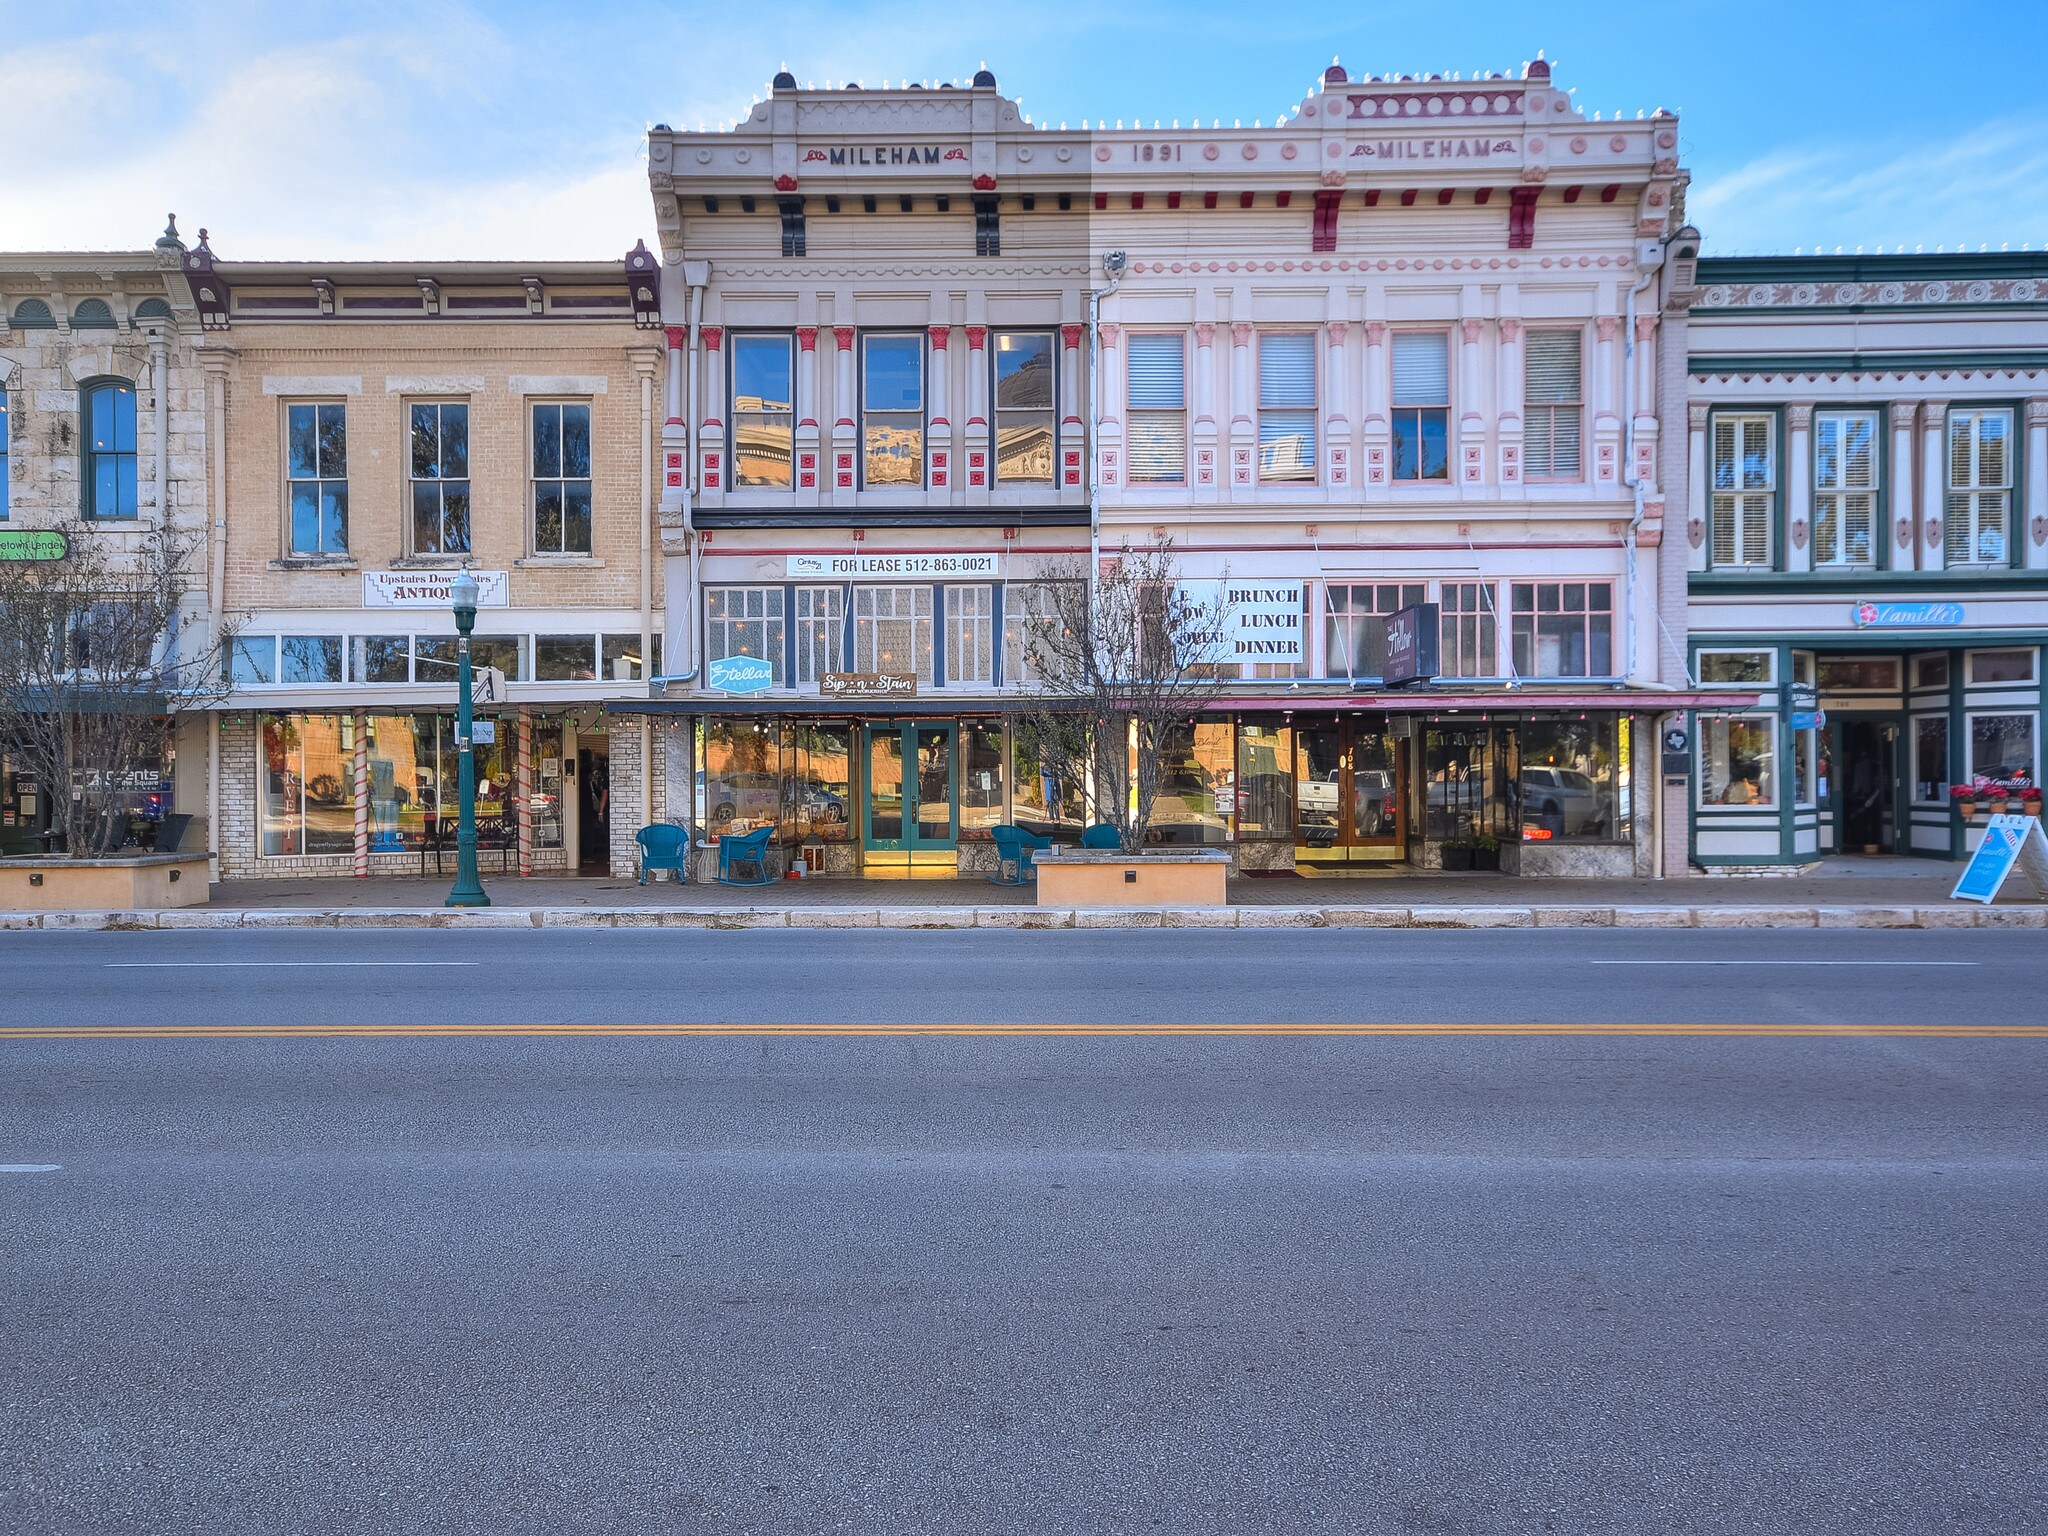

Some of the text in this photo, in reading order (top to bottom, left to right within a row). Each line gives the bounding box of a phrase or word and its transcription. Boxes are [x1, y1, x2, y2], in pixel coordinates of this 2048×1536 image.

[830, 147, 940, 165] MILEHAM
[1133, 144, 1181, 162] 1891
[1378, 139, 1491, 159] MILEHAM
[832, 557, 992, 572] FOR LEASE 512-863-0021
[380, 574, 427, 585] Upstairs
[1228, 589, 1299, 603] BRUNCH
[1880, 603, 1959, 623] Camille's
[1241, 614, 1298, 628] LUNCH
[1234, 640, 1299, 654] DINNER
[711, 664, 771, 687] Stellar
[18, 784, 37, 792] OPEN
[134, 780, 159, 788] Square
[284, 745, 299, 840] HARVEST
